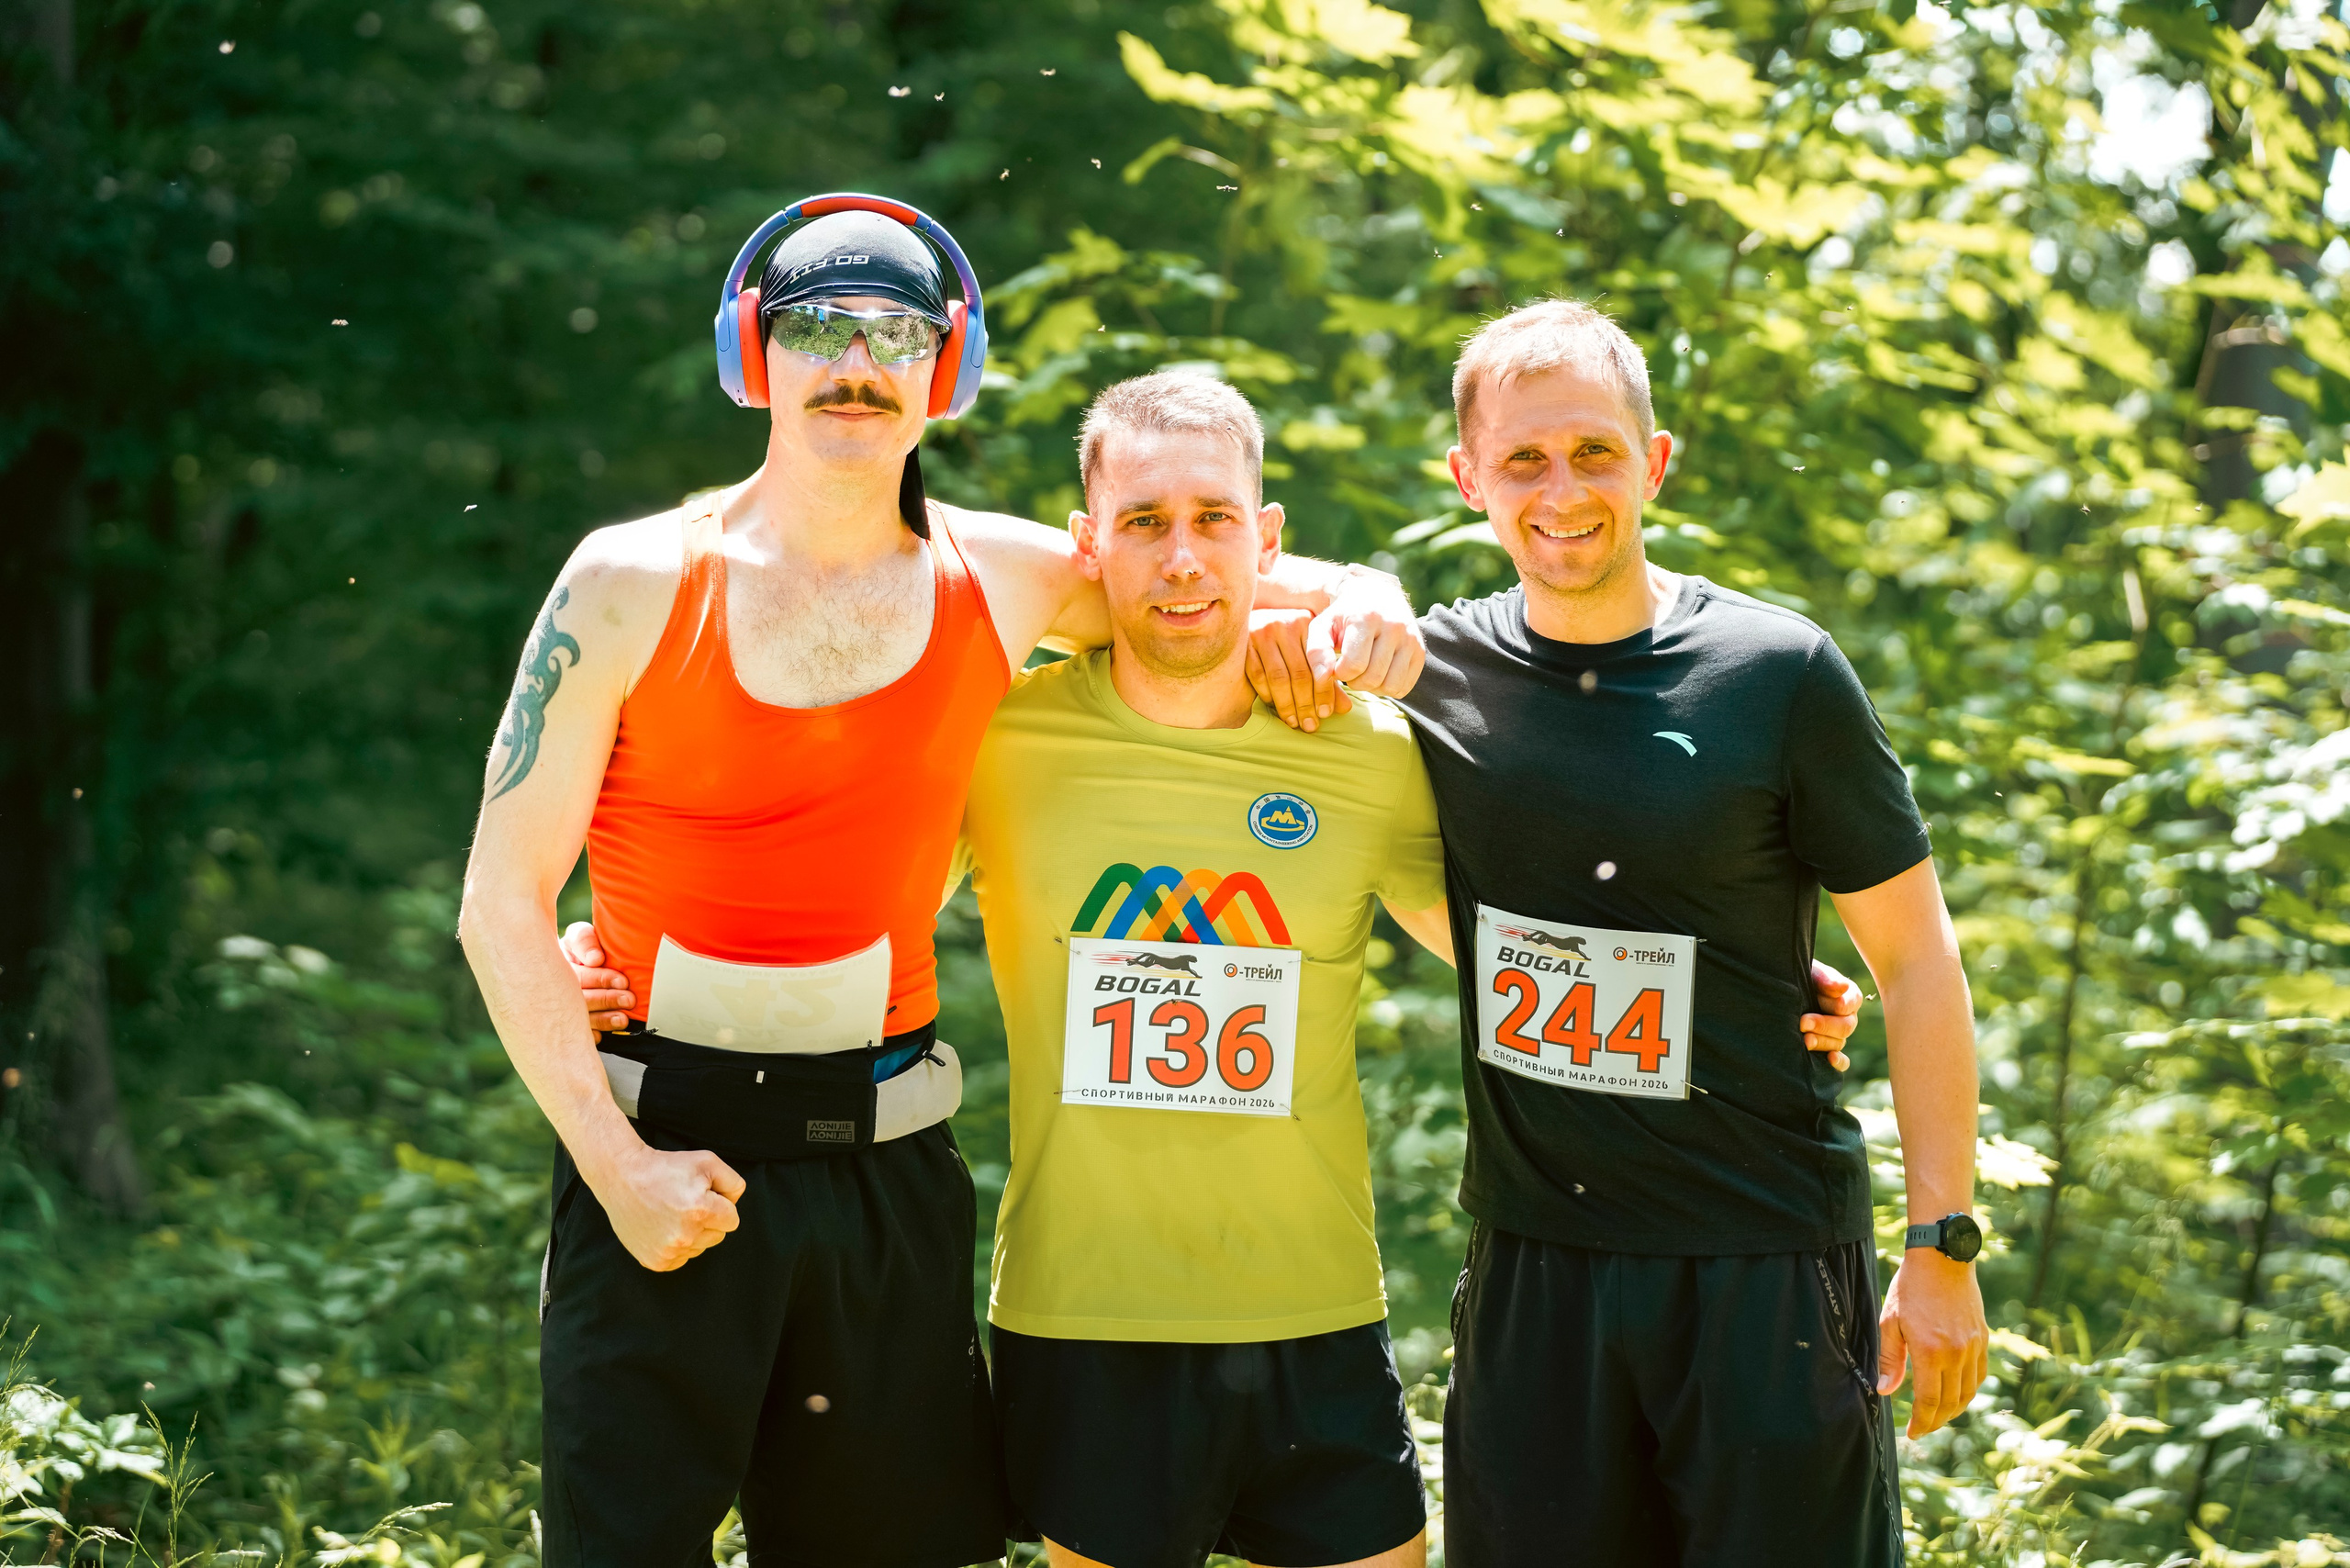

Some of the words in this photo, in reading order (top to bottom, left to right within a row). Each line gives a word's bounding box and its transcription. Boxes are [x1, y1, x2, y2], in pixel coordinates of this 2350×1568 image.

[789, 257, 828, 285] FIT
[834, 254, 870, 266] GO
[1496, 946, 1591, 979] BOGAL
[1093, 974, 1203, 997] BOGAL
[1493, 967, 1671, 1074] 244
[1092, 997, 1274, 1092] 136
[1493, 1048, 1565, 1079] СПОРТИВНЫЙ
[1568, 1070, 1638, 1088] МАРАФОН
[1640, 1079, 1669, 1091] 2026
[1081, 1088, 1174, 1103] СПОРТИВНЫЙ
[1178, 1092, 1247, 1107] МАРАФОН
[1249, 1098, 1275, 1108] 2026
[810, 1131, 852, 1140] AONIJIE
[811, 1122, 852, 1131] AONIJIE
[1816, 1257, 1841, 1316] ATHLEX
